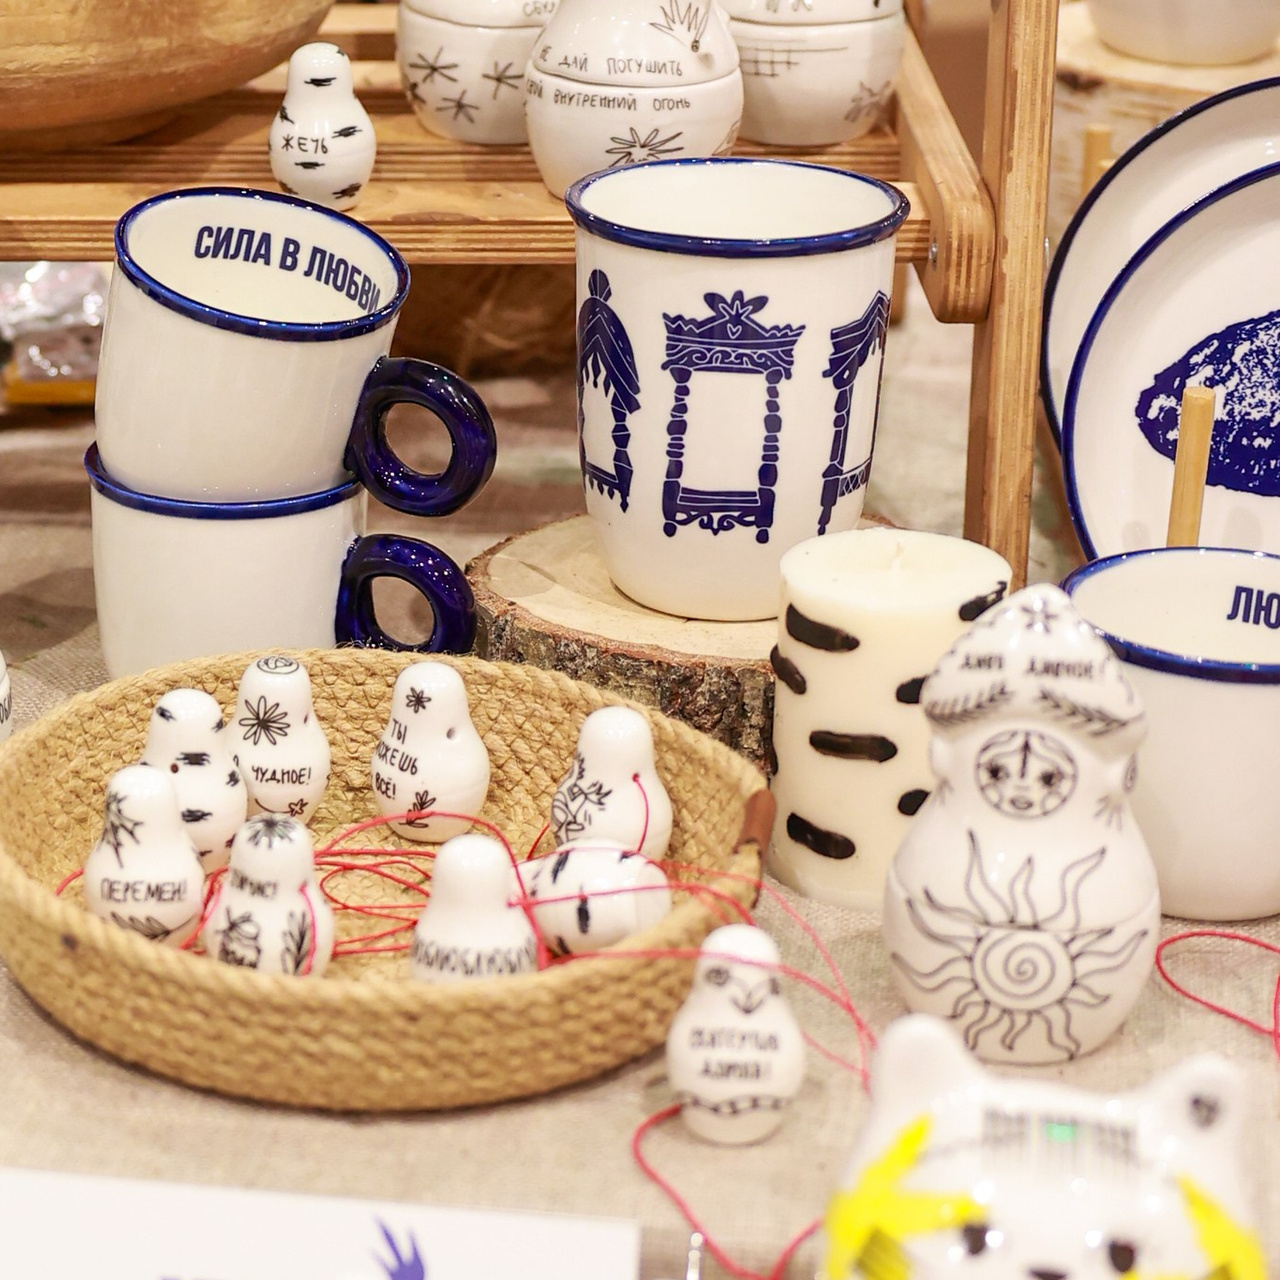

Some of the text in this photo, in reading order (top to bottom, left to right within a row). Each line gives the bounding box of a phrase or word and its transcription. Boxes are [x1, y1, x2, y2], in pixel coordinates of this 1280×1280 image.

[558, 53, 588, 72] ДАЙ
[554, 88, 637, 111] ВНУТРЕННИЙ
[653, 98, 691, 112] ОГОНЬ
[194, 225, 272, 267] СИЛА
[279, 237, 300, 272] В
[391, 717, 408, 745] ТЫ
[251, 765, 312, 786] ЧУДНОЕ!
